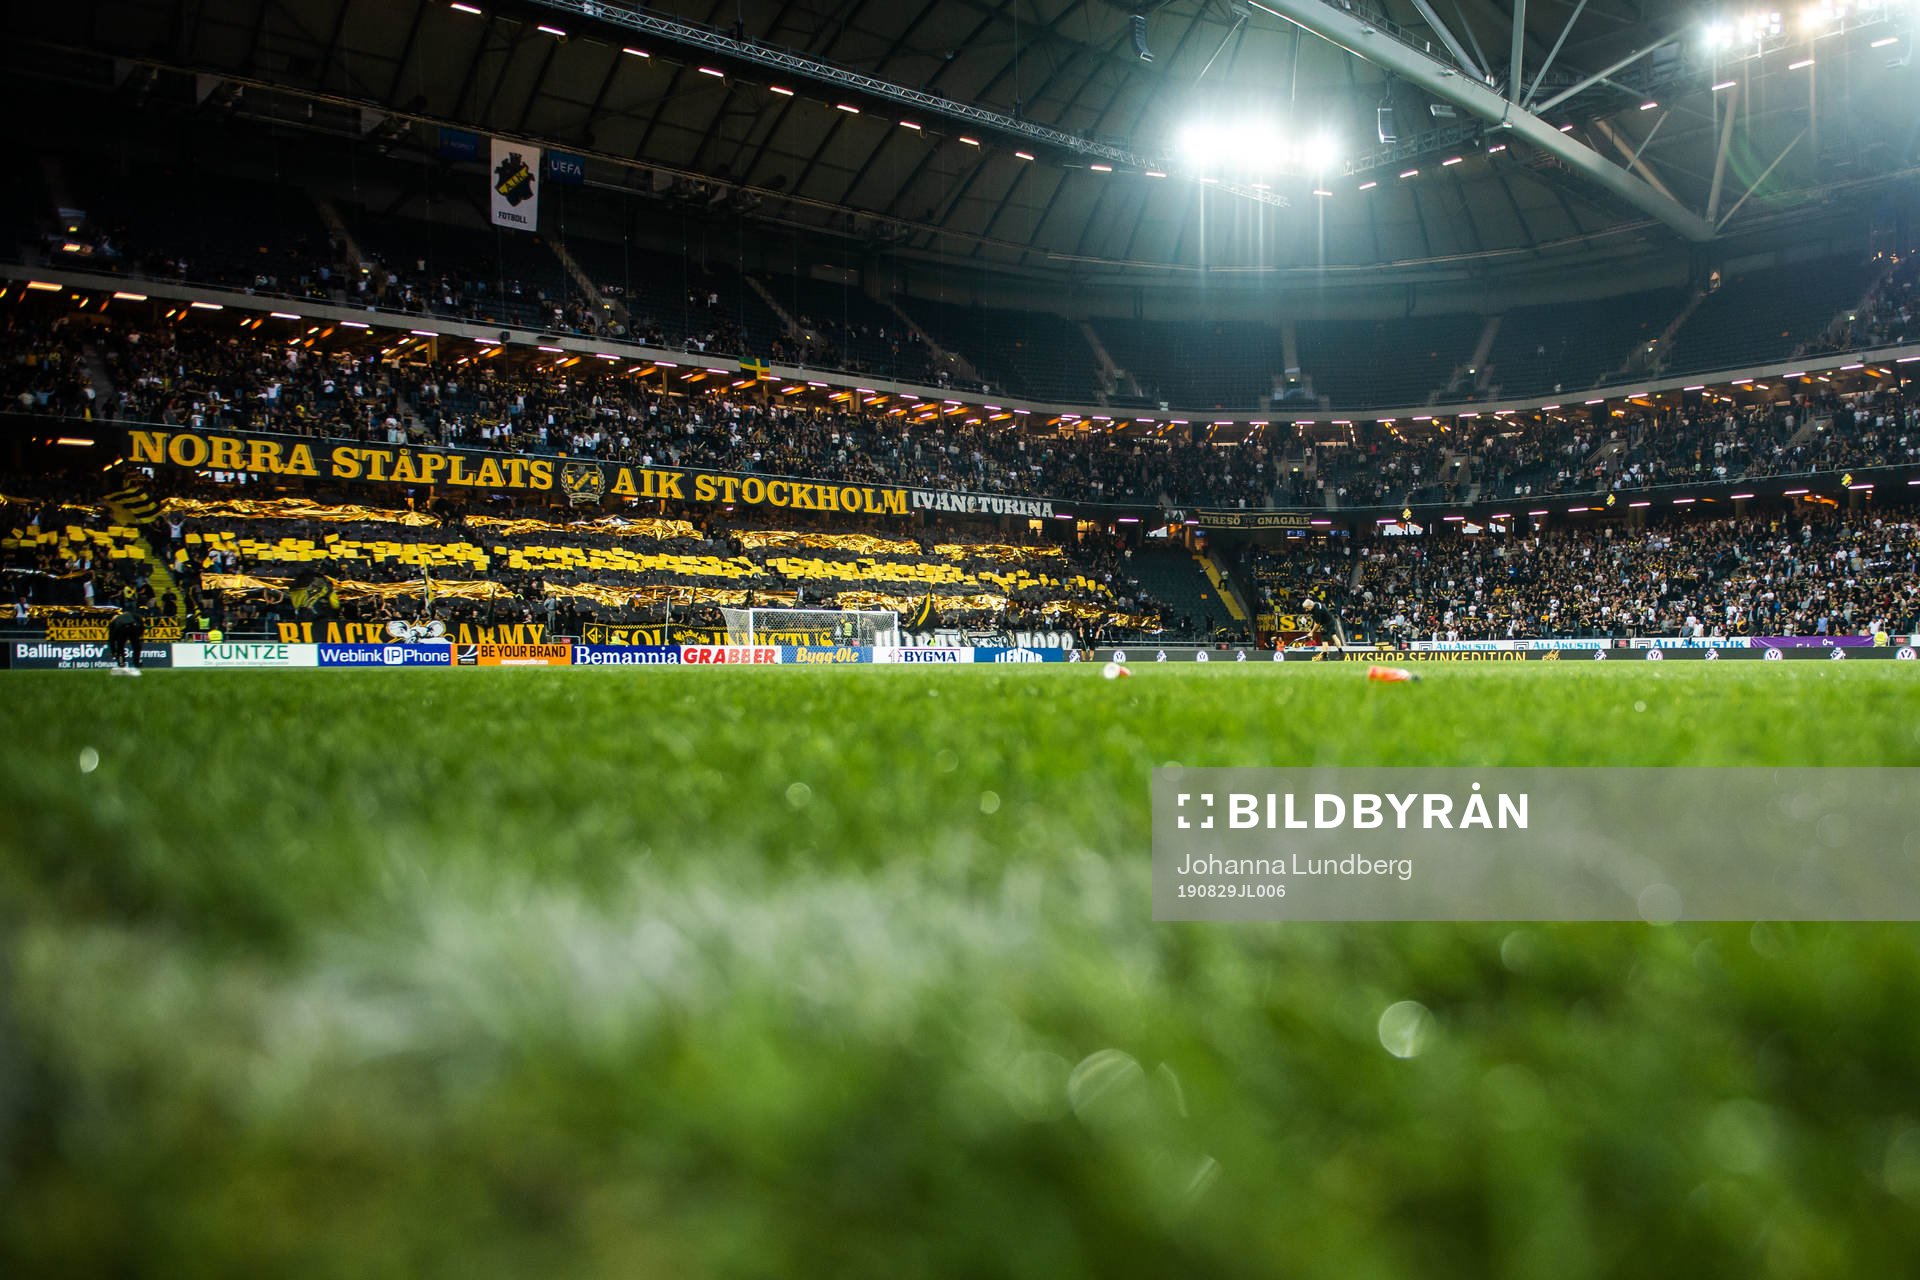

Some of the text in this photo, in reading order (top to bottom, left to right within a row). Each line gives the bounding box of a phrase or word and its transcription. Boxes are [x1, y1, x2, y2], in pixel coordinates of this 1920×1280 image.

[551, 160, 581, 176] UEFA
[498, 211, 528, 224] FOTBOLL
[128, 430, 910, 515] NORRA STÅPLATS AIK STOCKHOLM
[912, 491, 1054, 518] IVAN TURINA
[1200, 514, 1241, 525] TYRESÖ
[1257, 516, 1311, 525] GNAGARE
[55, 629, 109, 640] KENNY
[16, 644, 104, 660] Ballingslöv
[204, 645, 289, 659] KUNTZE
[320, 649, 383, 662] Weblink
[403, 649, 449, 662] Phone
[481, 645, 566, 657] BE YOUR BRAND
[574, 646, 678, 664] Bemannia
[683, 648, 776, 664] GRABBER
[904, 651, 957, 662] BYGMA
